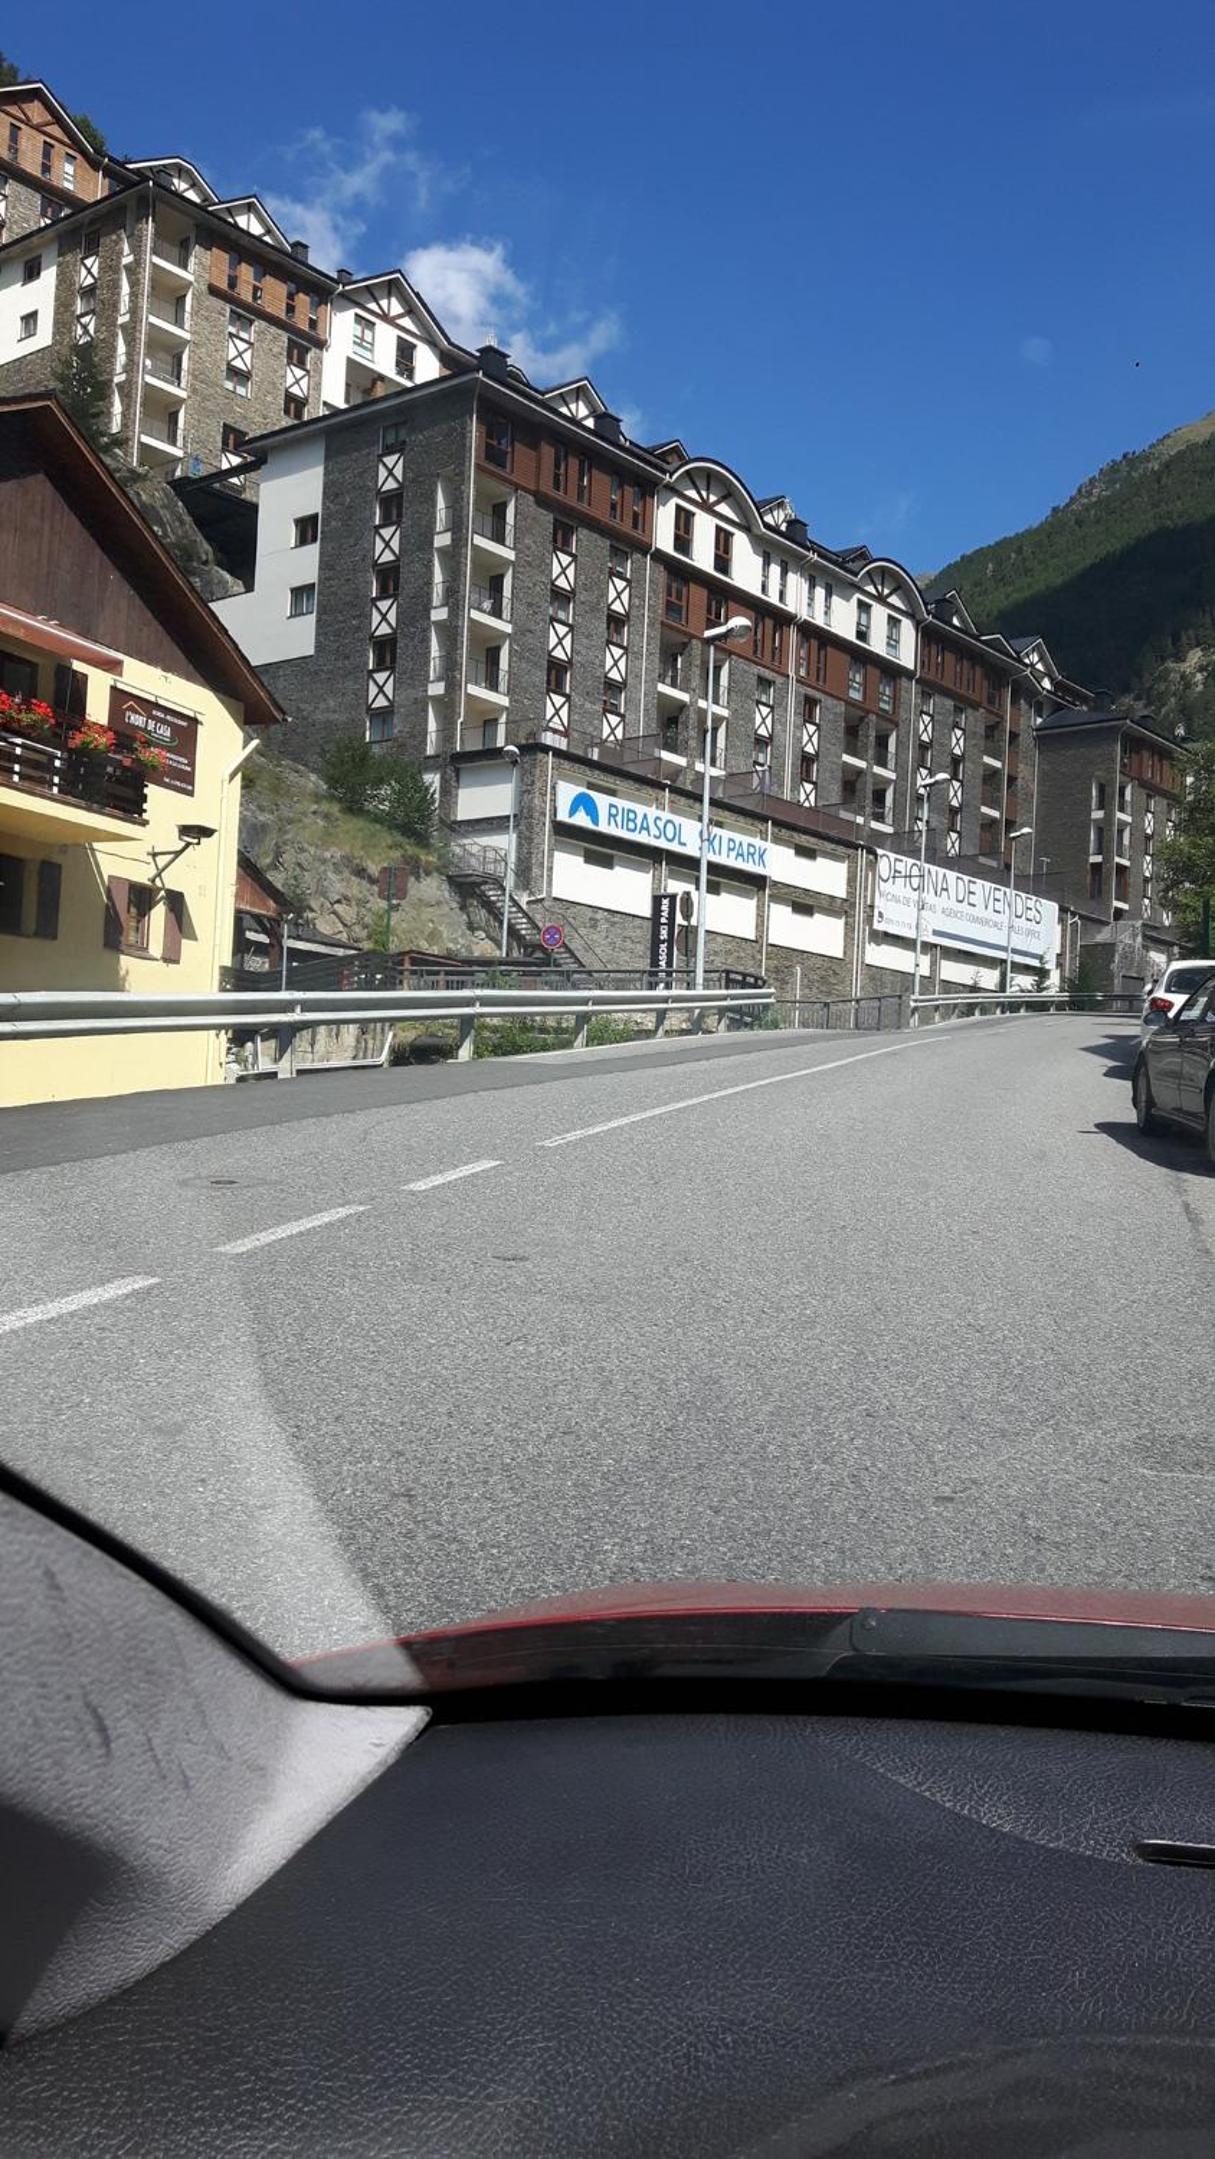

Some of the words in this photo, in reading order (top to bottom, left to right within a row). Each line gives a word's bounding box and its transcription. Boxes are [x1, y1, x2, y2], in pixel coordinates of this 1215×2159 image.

[147, 719, 156, 731] DE
[607, 803, 687, 847] RIBASOL
[727, 837, 768, 869] PARK
[660, 897, 670, 923] PARK
[878, 853, 951, 901] OFICINA
[956, 876, 976, 907] DE
[981, 883, 1043, 925] VENDES
